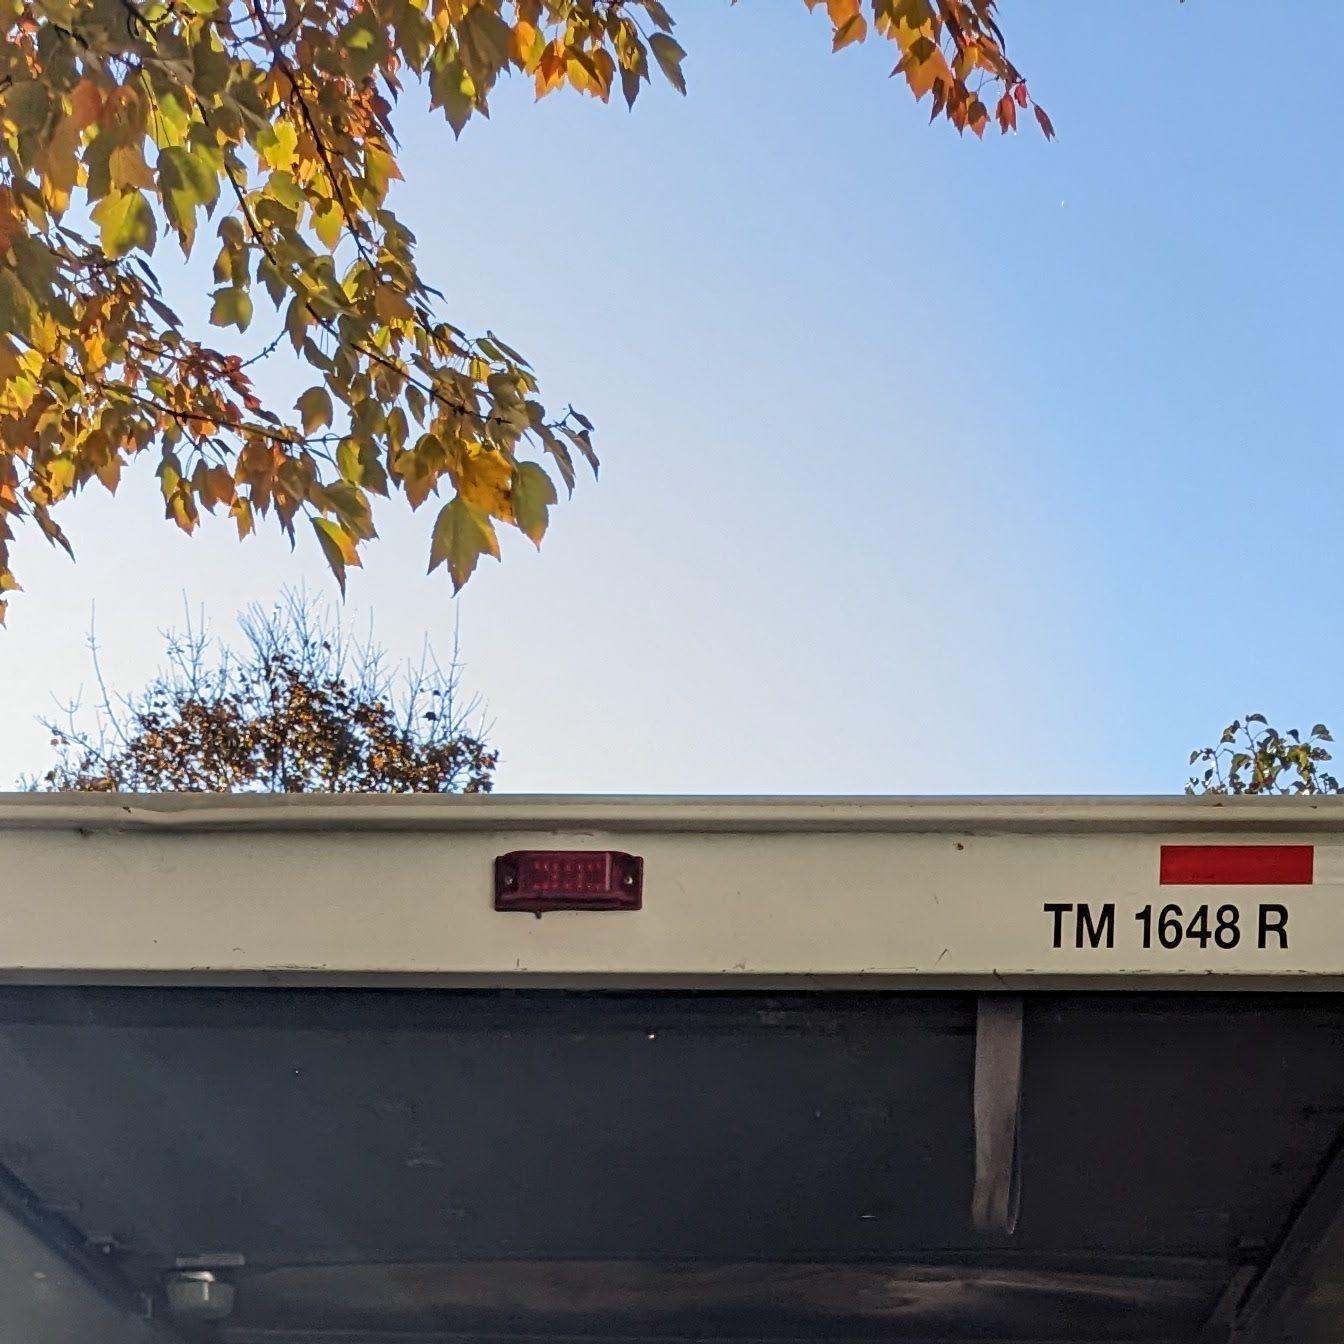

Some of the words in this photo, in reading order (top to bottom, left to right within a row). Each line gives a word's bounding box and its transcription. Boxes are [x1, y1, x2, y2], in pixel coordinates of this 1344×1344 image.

[1043, 903, 1116, 949] TM
[1135, 903, 1241, 950] 1648
[1258, 903, 1289, 949] R
